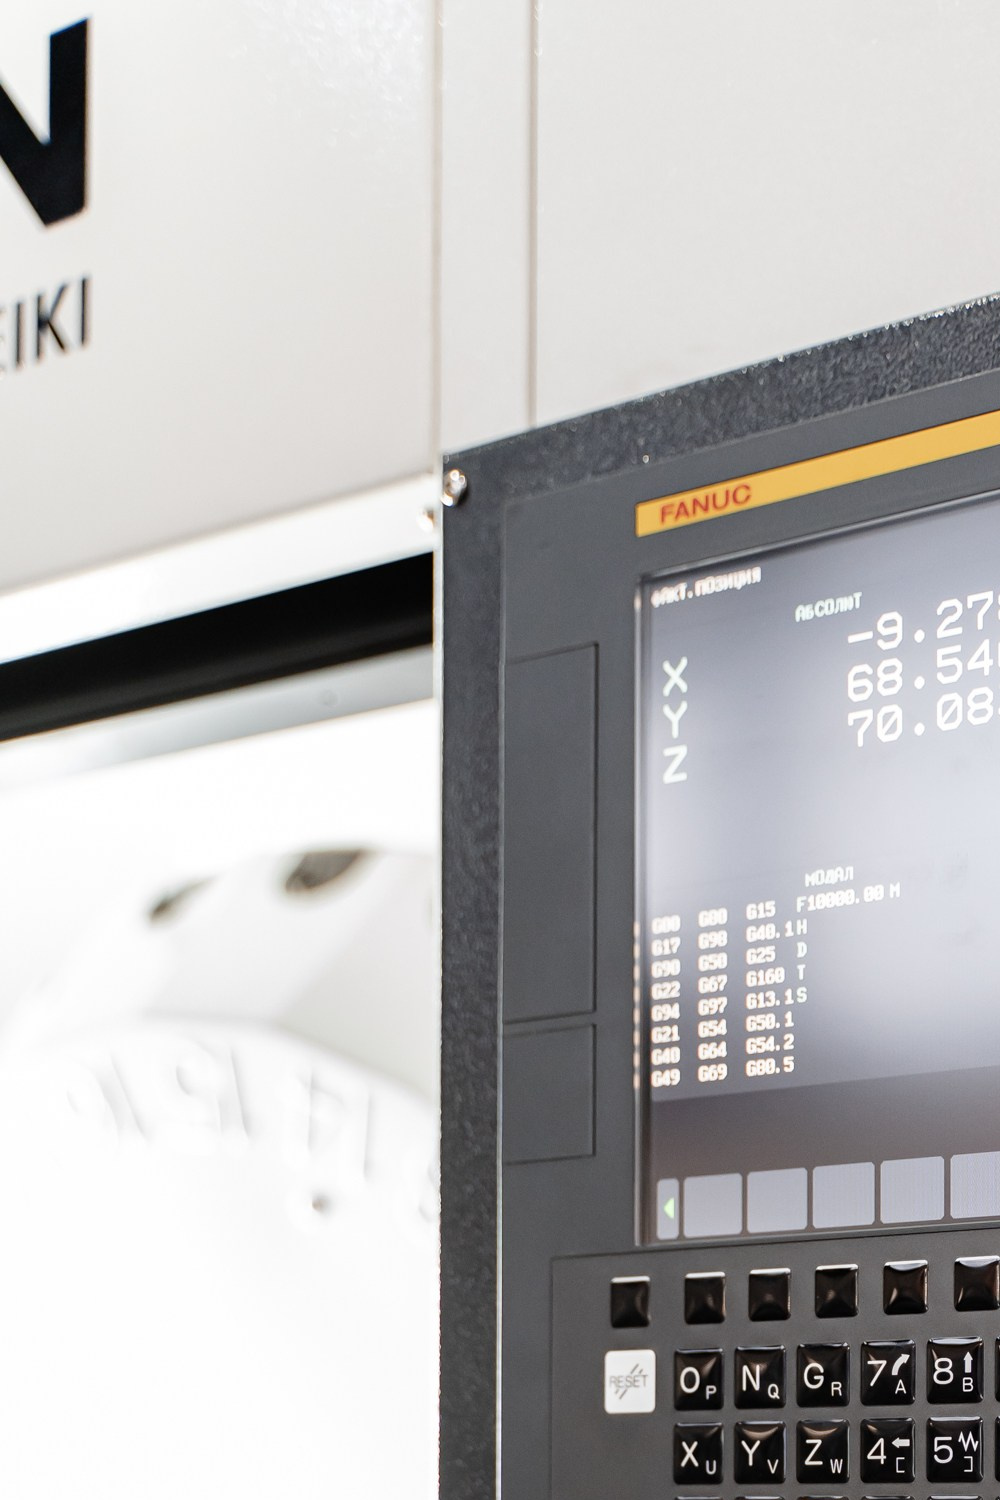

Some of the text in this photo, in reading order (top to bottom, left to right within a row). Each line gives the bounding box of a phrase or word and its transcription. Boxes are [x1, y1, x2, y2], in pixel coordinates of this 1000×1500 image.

[659, 484, 752, 525] FANUC
[662, 657, 688, 696] X
[662, 700, 688, 739] Y
[662, 745, 688, 784] Z
[746, 901, 776, 920] G15
[651, 937, 681, 956] G17
[746, 921, 794, 942] G40.1
[651, 959, 681, 978] G90
[746, 946, 776, 965] G25
[651, 967, 785, 1000] G22 G67 G160
[651, 989, 794, 1022] G94 G97 G13.1
[651, 1011, 794, 1043] G21 G54 G50.1
[651, 1034, 794, 1065] G40 G64 G54.2
[651, 1056, 794, 1087] G49 G69 G80.5
[609, 1374, 648, 1388] RESET
